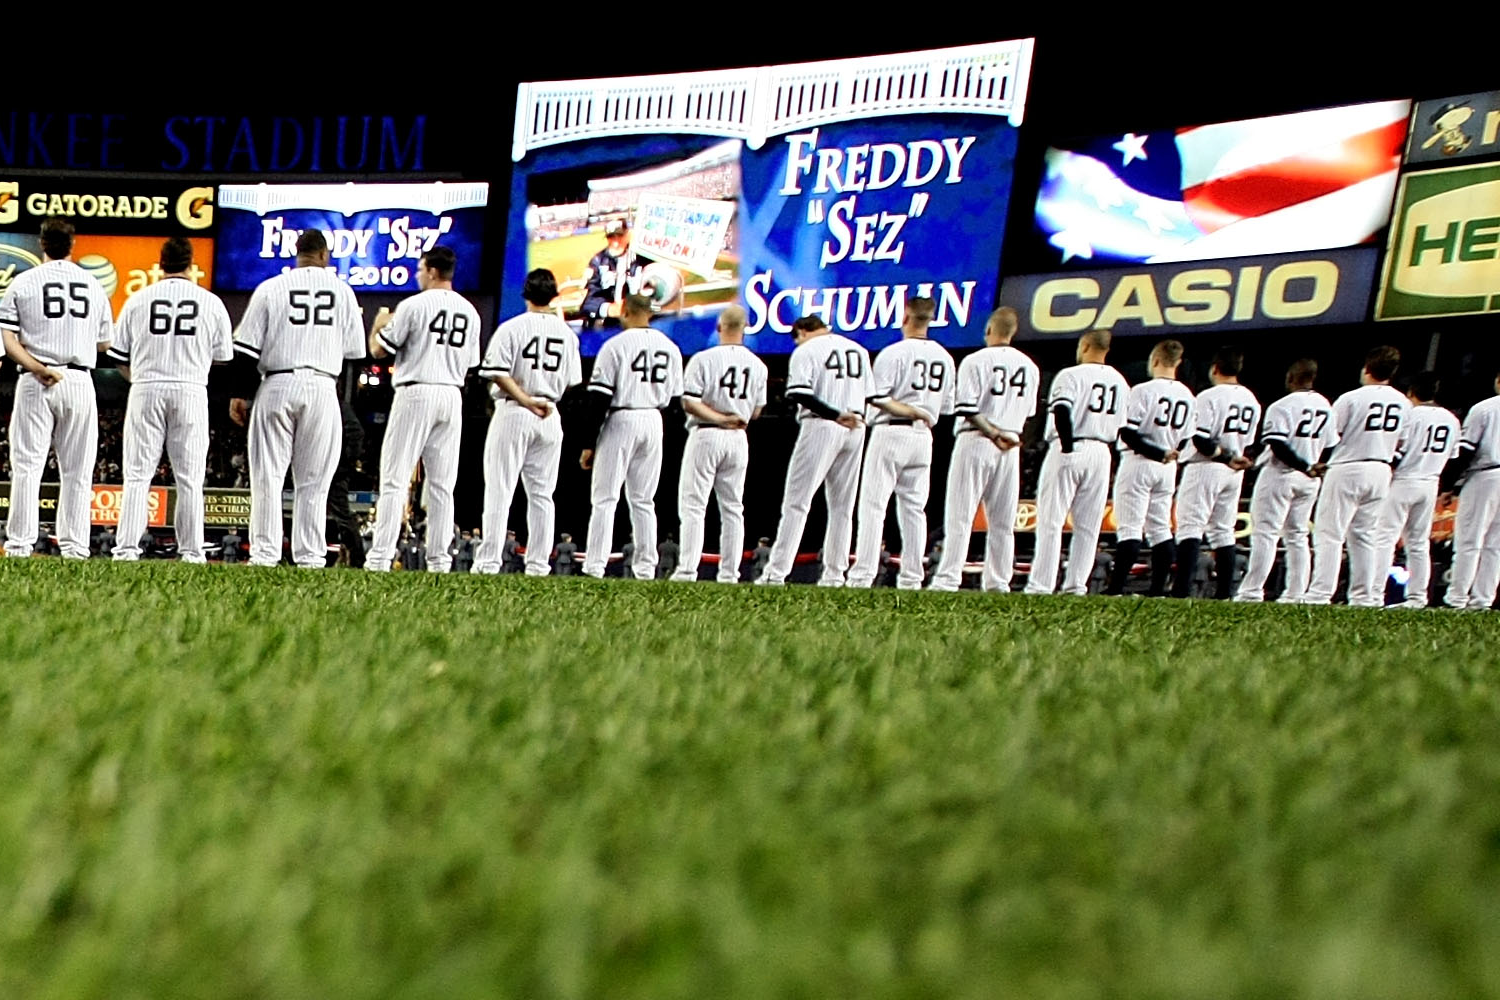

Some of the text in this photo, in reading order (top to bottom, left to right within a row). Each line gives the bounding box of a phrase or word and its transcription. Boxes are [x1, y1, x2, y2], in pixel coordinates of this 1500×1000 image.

[161, 114, 427, 172] STADIUM
[779, 127, 976, 197] FREDDY
[26, 192, 168, 219] GATORADE
[176, 187, 214, 230] G
[43, 283, 89, 318] 65
[289, 291, 335, 325] 52
[745, 269, 976, 335] SCHUMN
[1030, 259, 1339, 333] CASIO
[150, 300, 198, 335] 62
[429, 311, 468, 348] 48
[522, 337, 563, 371] 45
[631, 351, 669, 384] 42
[825, 350, 861, 378] 40
[720, 367, 749, 399] 41
[911, 361, 944, 392] 39
[990, 367, 1025, 396] 34
[1090, 384, 1116, 414] 31
[1155, 398, 1188, 429] 30
[1225, 405, 1254, 437] 29
[1297, 411, 1328, 438] 27
[1366, 403, 1400, 431] 26
[1423, 426, 1449, 452] 19
